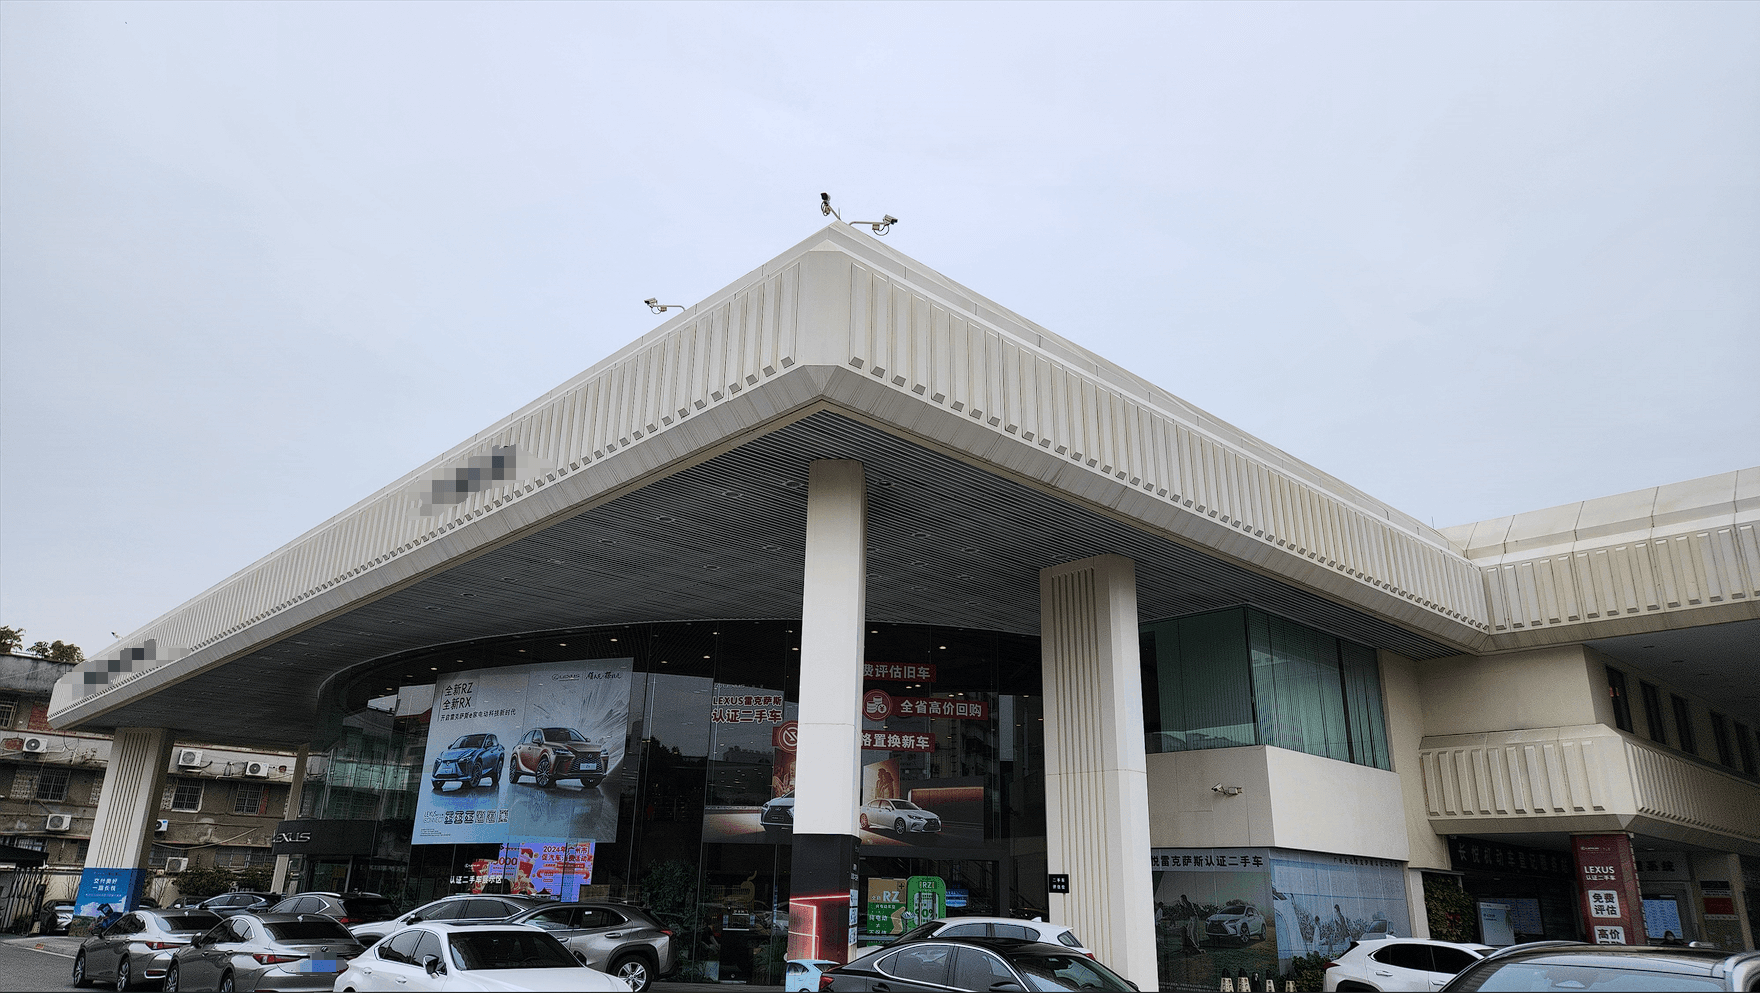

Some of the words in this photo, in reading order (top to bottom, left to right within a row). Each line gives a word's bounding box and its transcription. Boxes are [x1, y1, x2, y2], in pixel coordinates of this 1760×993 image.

[445, 682, 474, 696] 全新RZ
[443, 697, 472, 710] 全新RX
[712, 695, 783, 706] LEXUS雷克萨斯
[901, 699, 982, 717] 全省高价回购
[711, 708, 783, 724] 认证二手车
[273, 832, 311, 843] LEXUS
[1583, 865, 1615, 874] LEXUS
[922, 881, 932, 889] RZ
[882, 890, 900, 903] RZ
[1592, 893, 1615, 904] 免费
[1594, 905, 1617, 915] 评估
[1597, 929, 1620, 940] 高价
